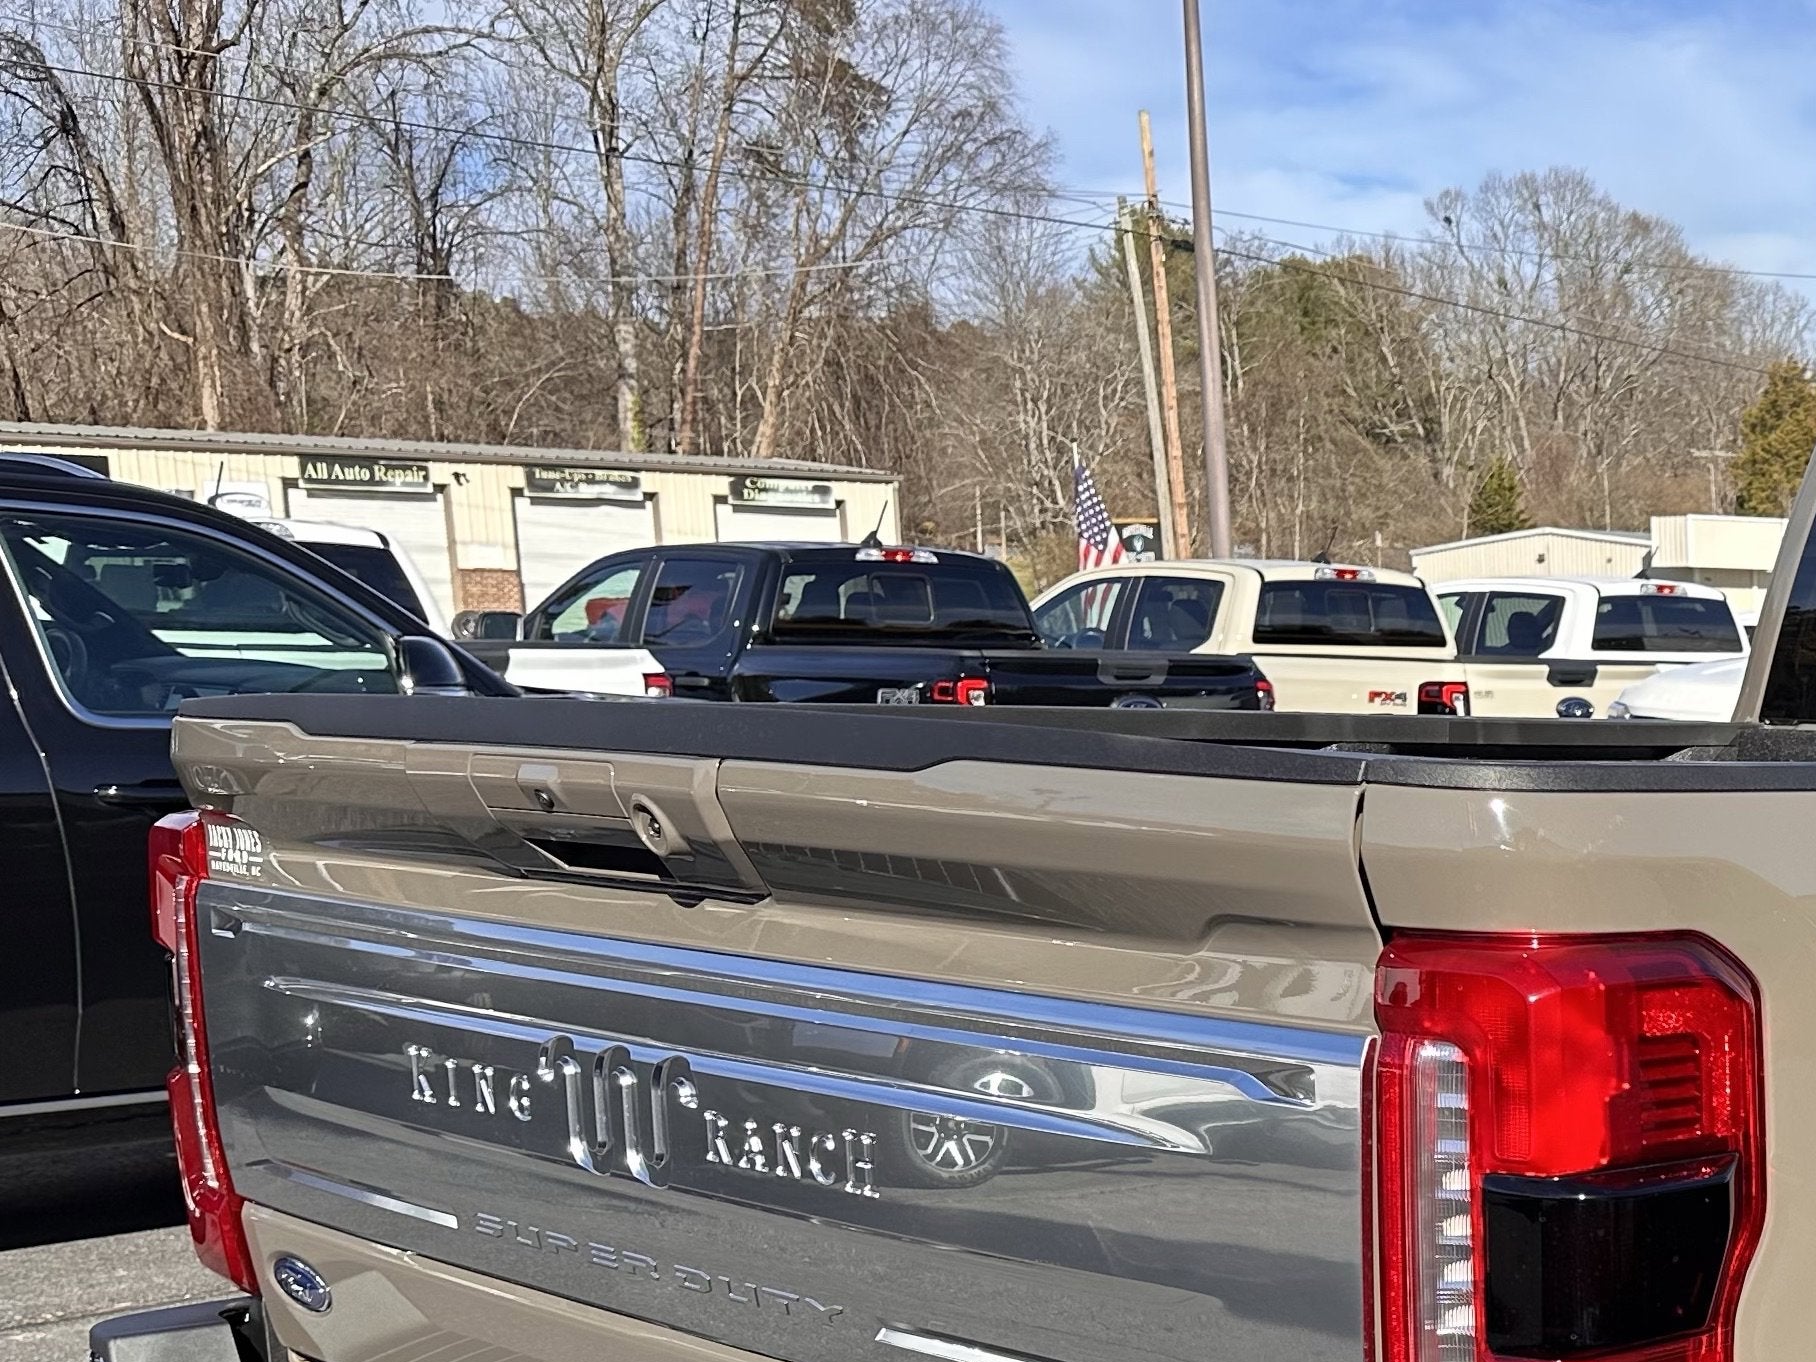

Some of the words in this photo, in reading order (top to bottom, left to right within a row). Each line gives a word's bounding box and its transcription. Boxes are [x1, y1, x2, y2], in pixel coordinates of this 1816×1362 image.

[304, 462, 328, 480] All
[331, 463, 371, 481] Auto
[373, 465, 427, 483] Repair
[1368, 691, 1408, 703] FX4
[405, 1043, 533, 1122] KING
[703, 1109, 880, 1199] RANCH
[474, 1211, 661, 1281] SUPER
[674, 1263, 844, 1326] DUTY
